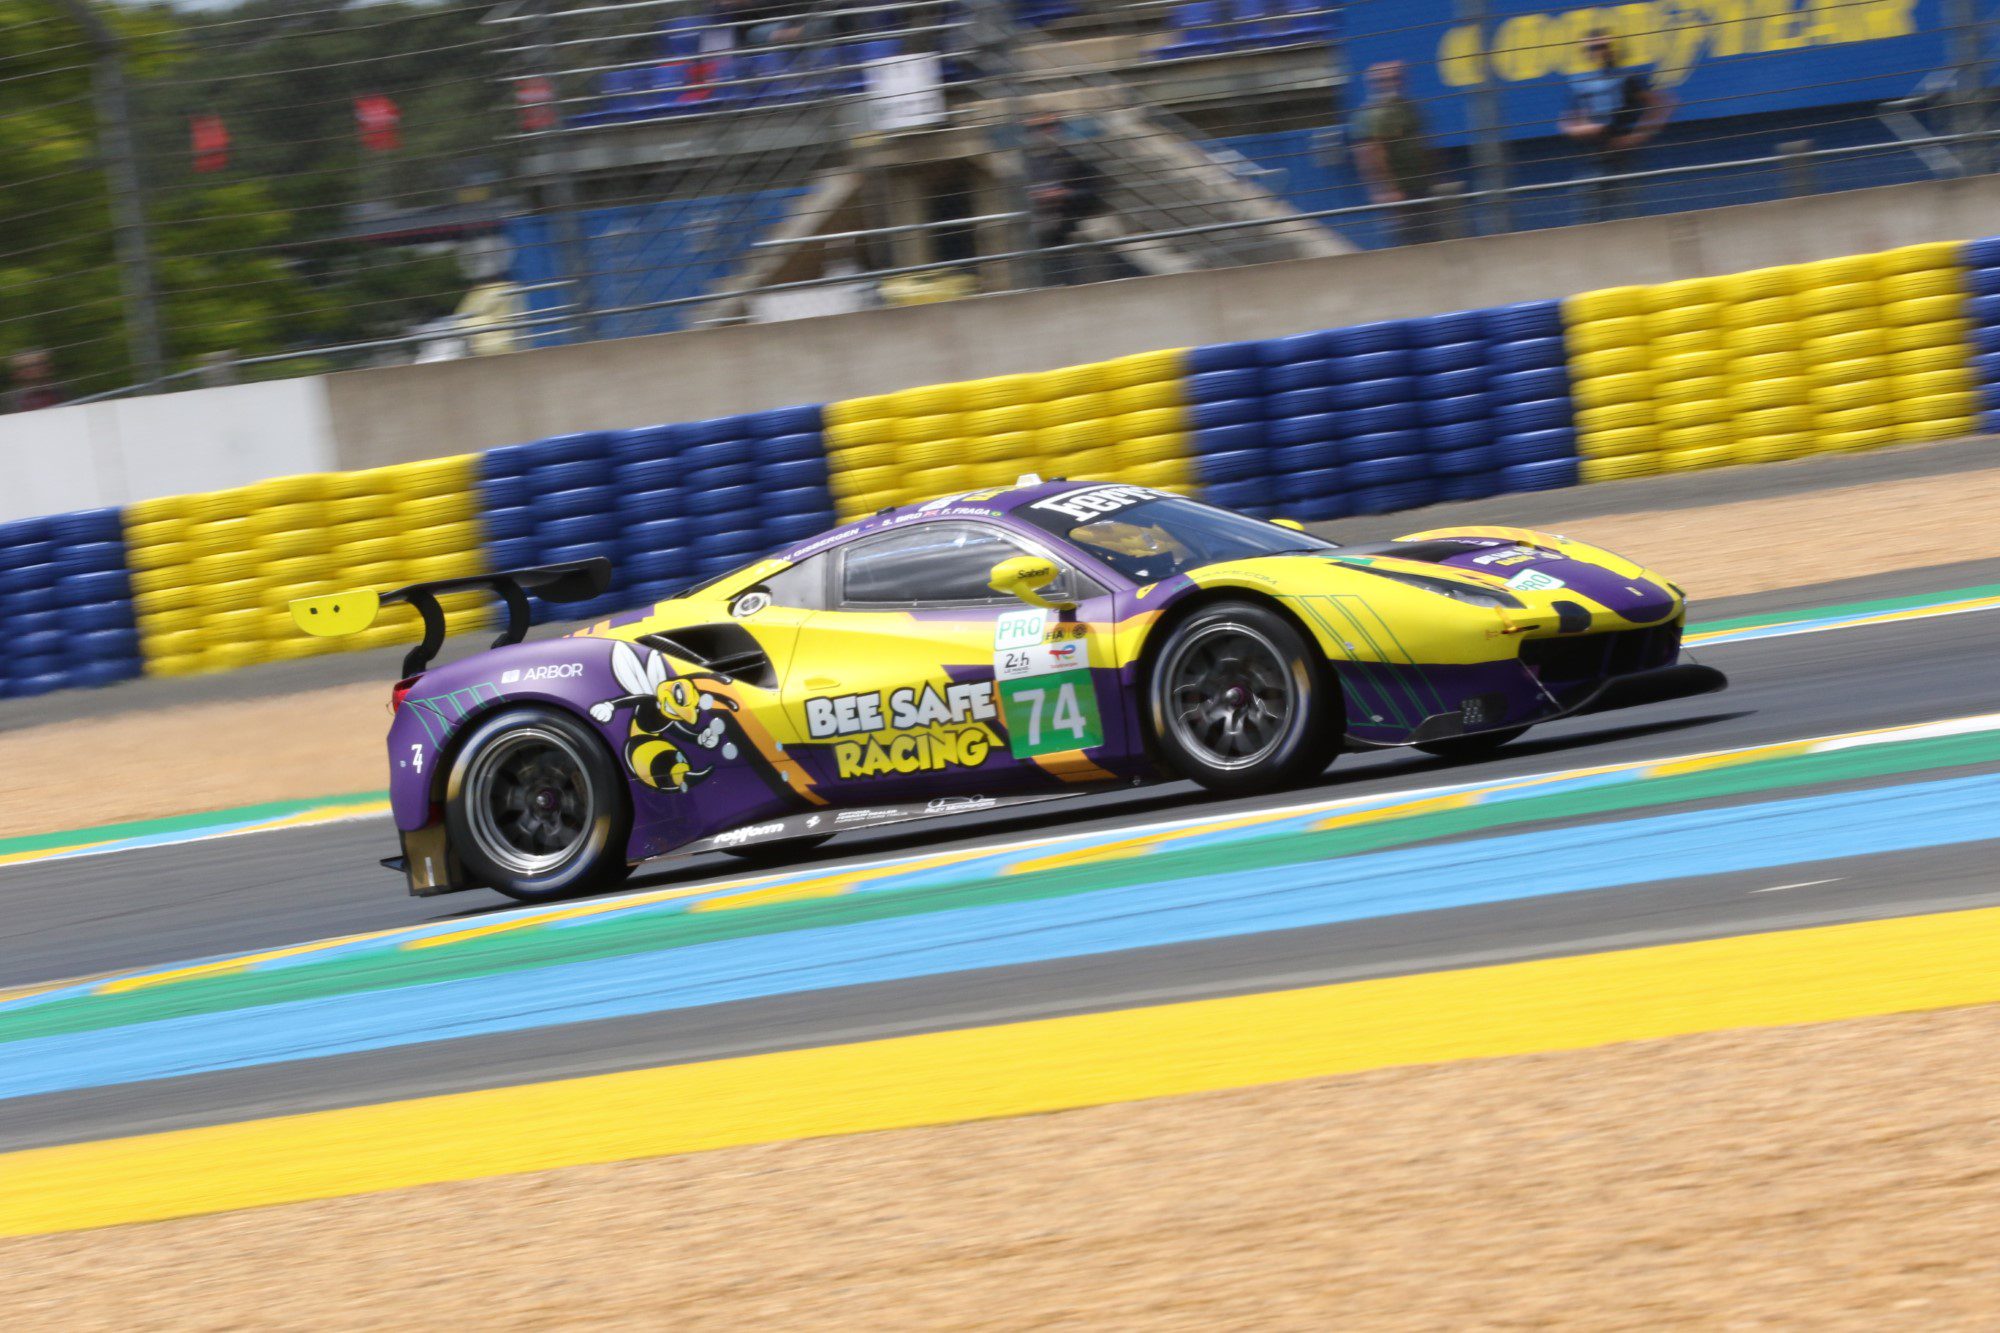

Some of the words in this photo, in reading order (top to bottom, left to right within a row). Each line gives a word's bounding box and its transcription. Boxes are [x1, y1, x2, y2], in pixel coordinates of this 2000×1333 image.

[895, 512, 923, 523] BIRD
[952, 507, 991, 516] FRAGA
[793, 527, 859, 558] GISBERGEN
[1515, 573, 1552, 592] PRO
[999, 616, 1042, 641] PRO
[1045, 630, 1065, 641] FIA
[523, 662, 584, 682] ARBOR
[805, 690, 885, 740] BEE
[889, 680, 998, 730] SAFE
[1012, 682, 1087, 747] 74
[834, 727, 990, 780] RACING
